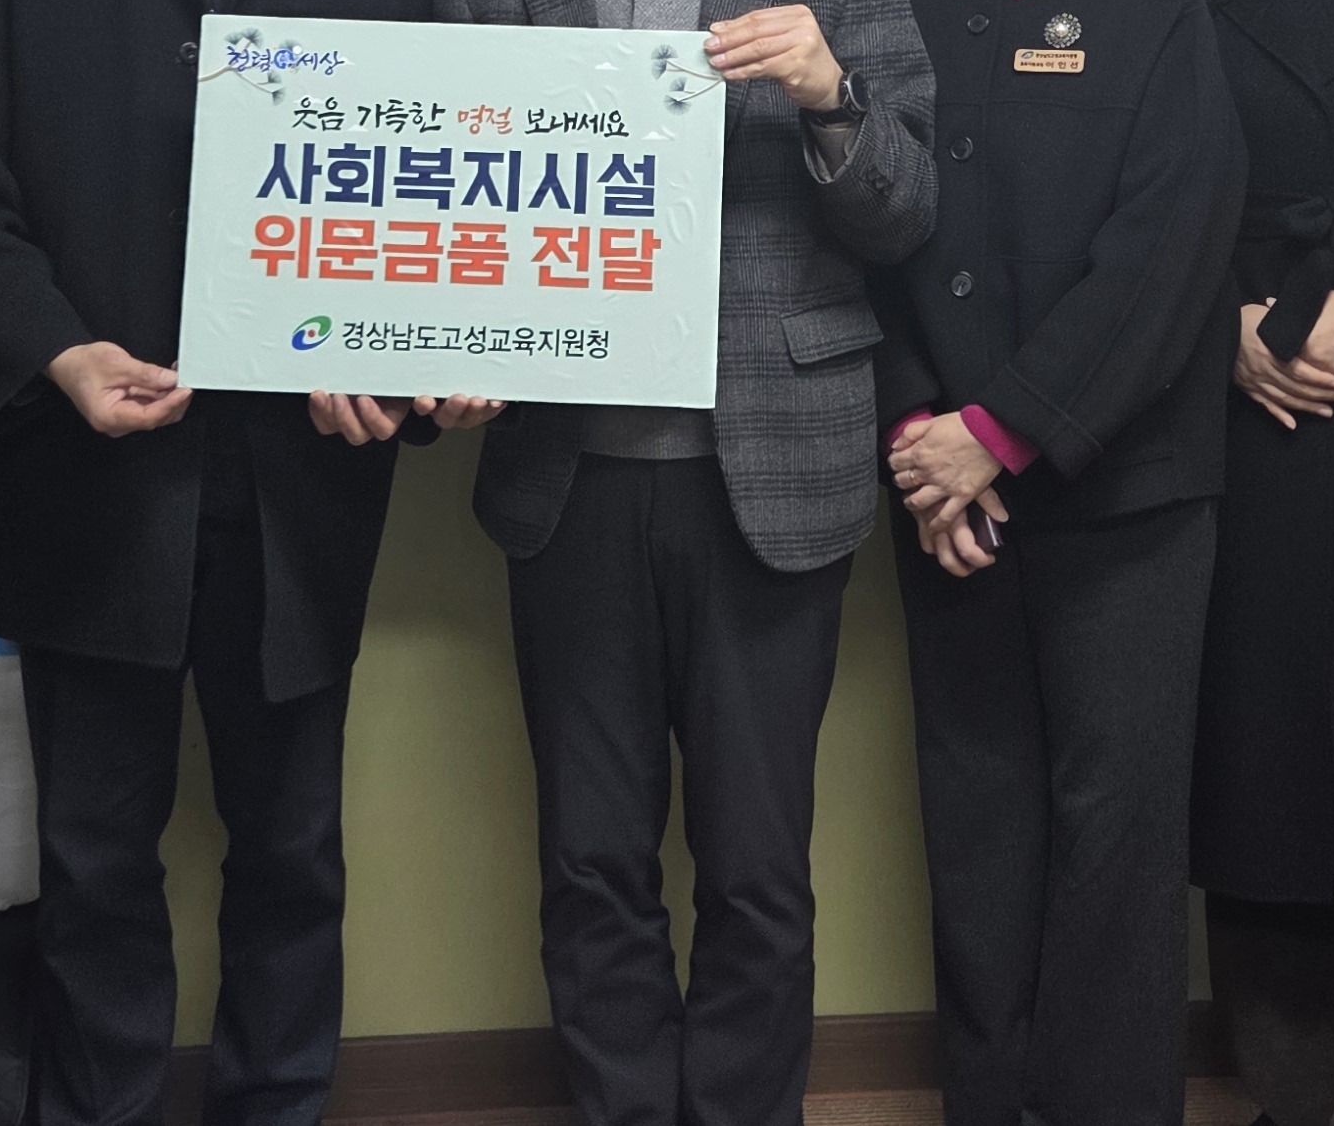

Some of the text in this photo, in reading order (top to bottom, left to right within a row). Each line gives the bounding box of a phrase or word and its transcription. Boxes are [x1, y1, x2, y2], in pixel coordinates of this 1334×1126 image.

[291, 96, 630, 138] 웃음 가득한 명절 보내세요
[257, 142, 657, 217] 사회복지시설
[250, 215, 662, 292] 위문금품 전달
[342, 321, 609, 359] 경상남도고성교육지원청
